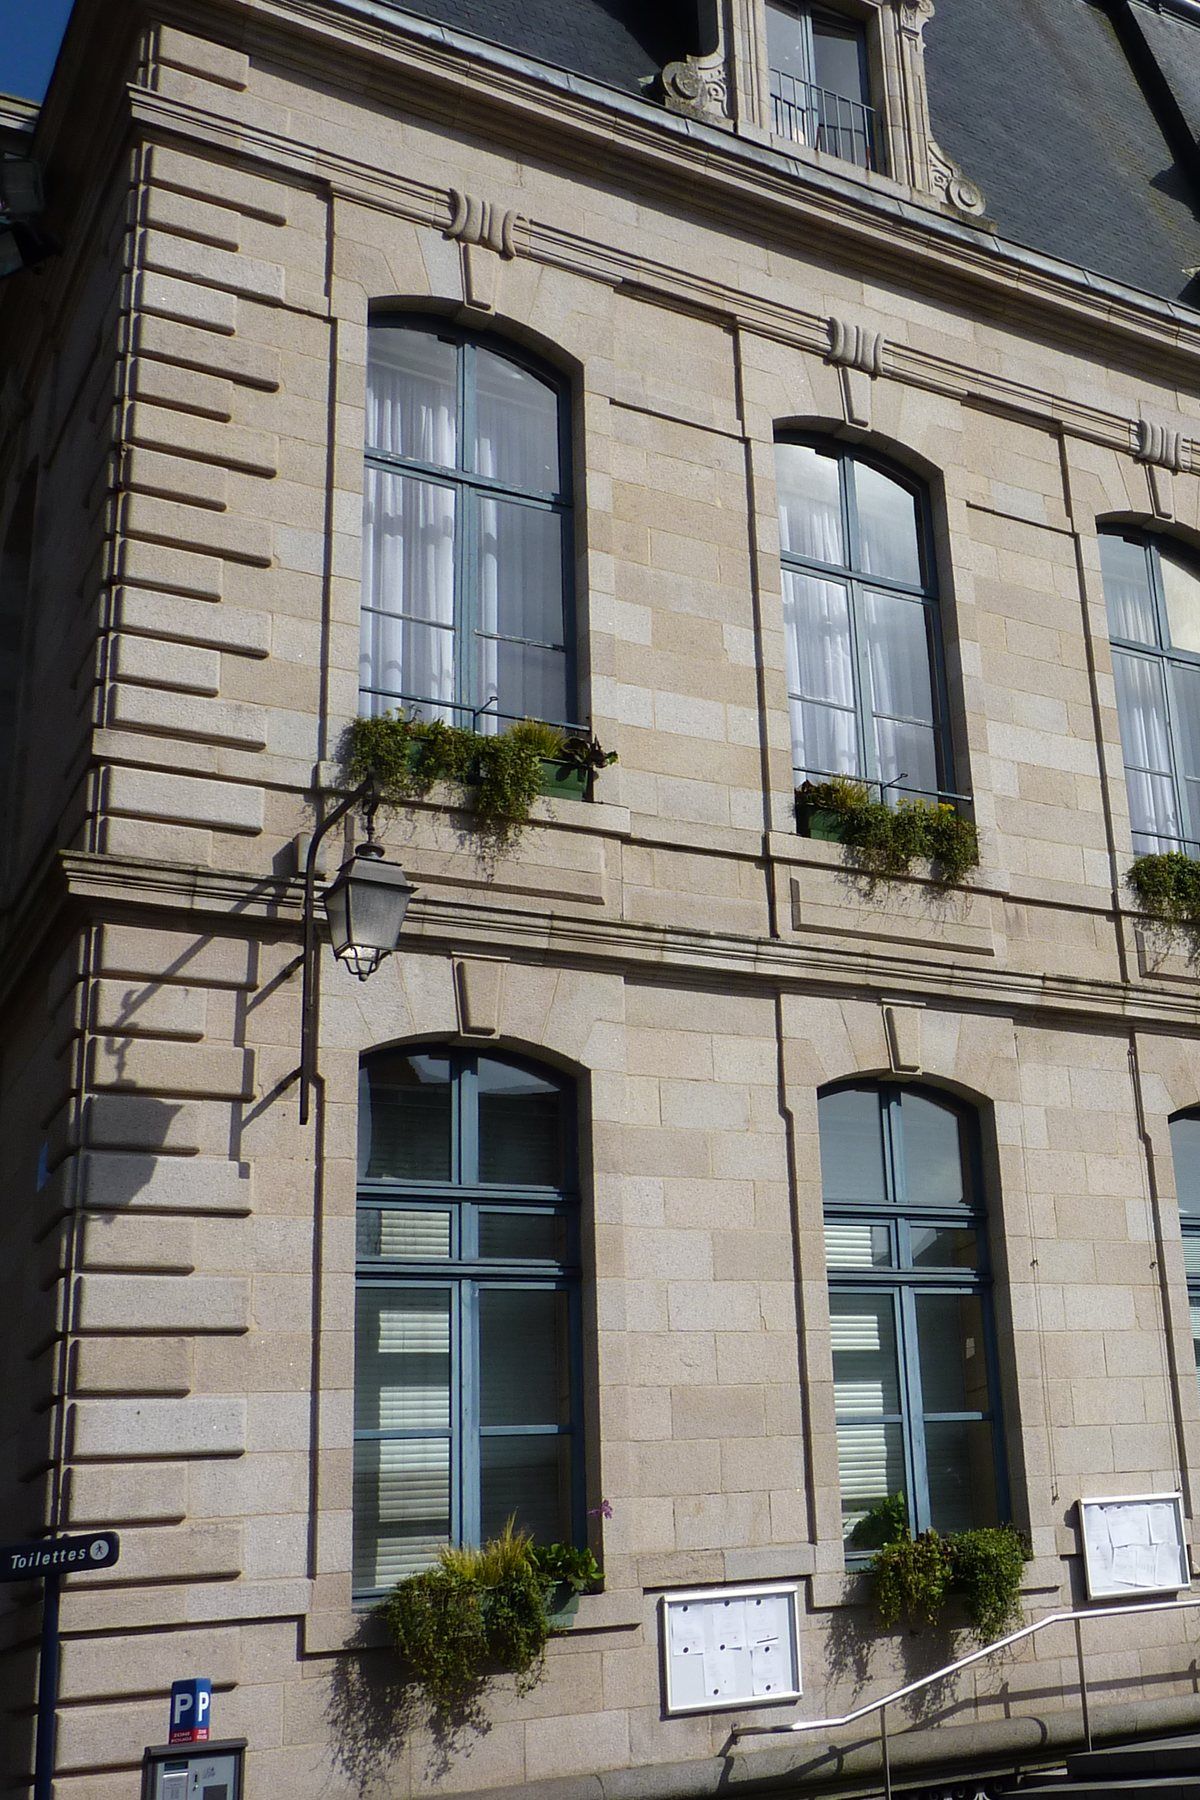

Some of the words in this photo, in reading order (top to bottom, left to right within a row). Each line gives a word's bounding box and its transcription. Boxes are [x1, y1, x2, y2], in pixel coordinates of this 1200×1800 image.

[10, 1548, 87, 1570] Toilettes
[174, 1693, 194, 1724] P
[198, 1691, 210, 1722] P
